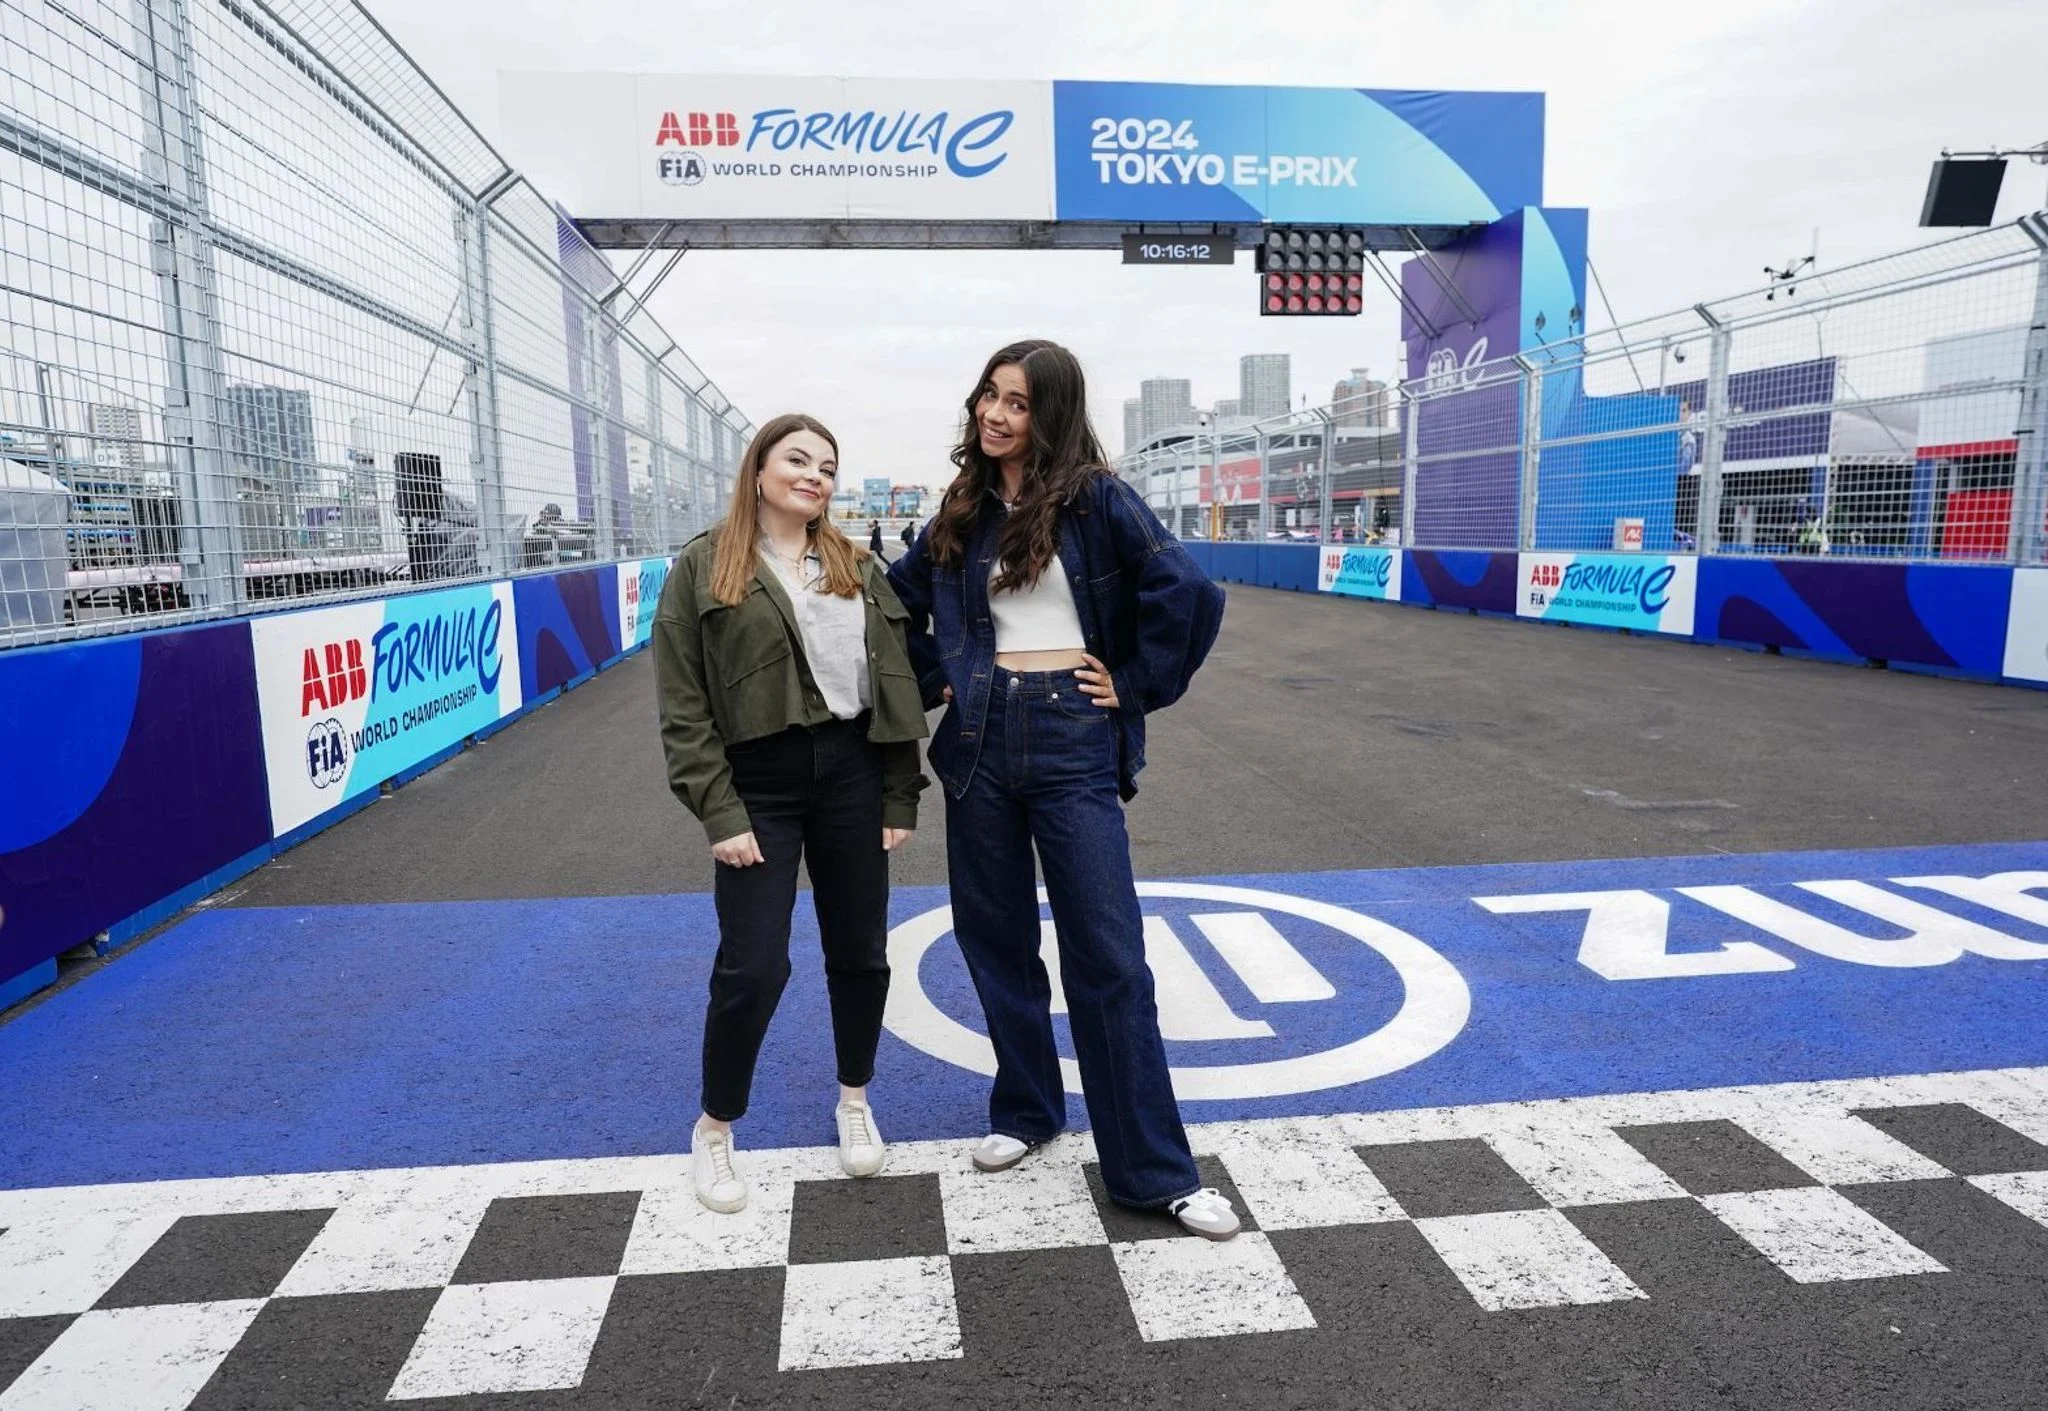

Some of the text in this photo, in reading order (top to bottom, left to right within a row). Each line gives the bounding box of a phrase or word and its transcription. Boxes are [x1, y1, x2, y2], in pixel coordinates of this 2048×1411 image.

[656, 112, 740, 146] ABB
[746, 109, 949, 155] FORMULA
[1091, 118, 1198, 150] 2024
[712, 163, 782, 177] WORLD
[790, 163, 938, 178] CHAMPIONSHIP
[1091, 153, 1358, 187] TOKYO E-PRIX
[1140, 244, 1210, 259] 10:16:12
[1531, 565, 1559, 586] ABB
[1560, 563, 1644, 597] FORMULA
[1549, 598, 1574, 607] WORLD
[1576, 599, 1636, 613] CHAMPIONSHIP
[301, 639, 366, 717] ABB
[371, 607, 476, 704] FORMULA
[351, 718, 398, 753] WORLD
[402, 684, 477, 732] CHAMPIONSHIP
